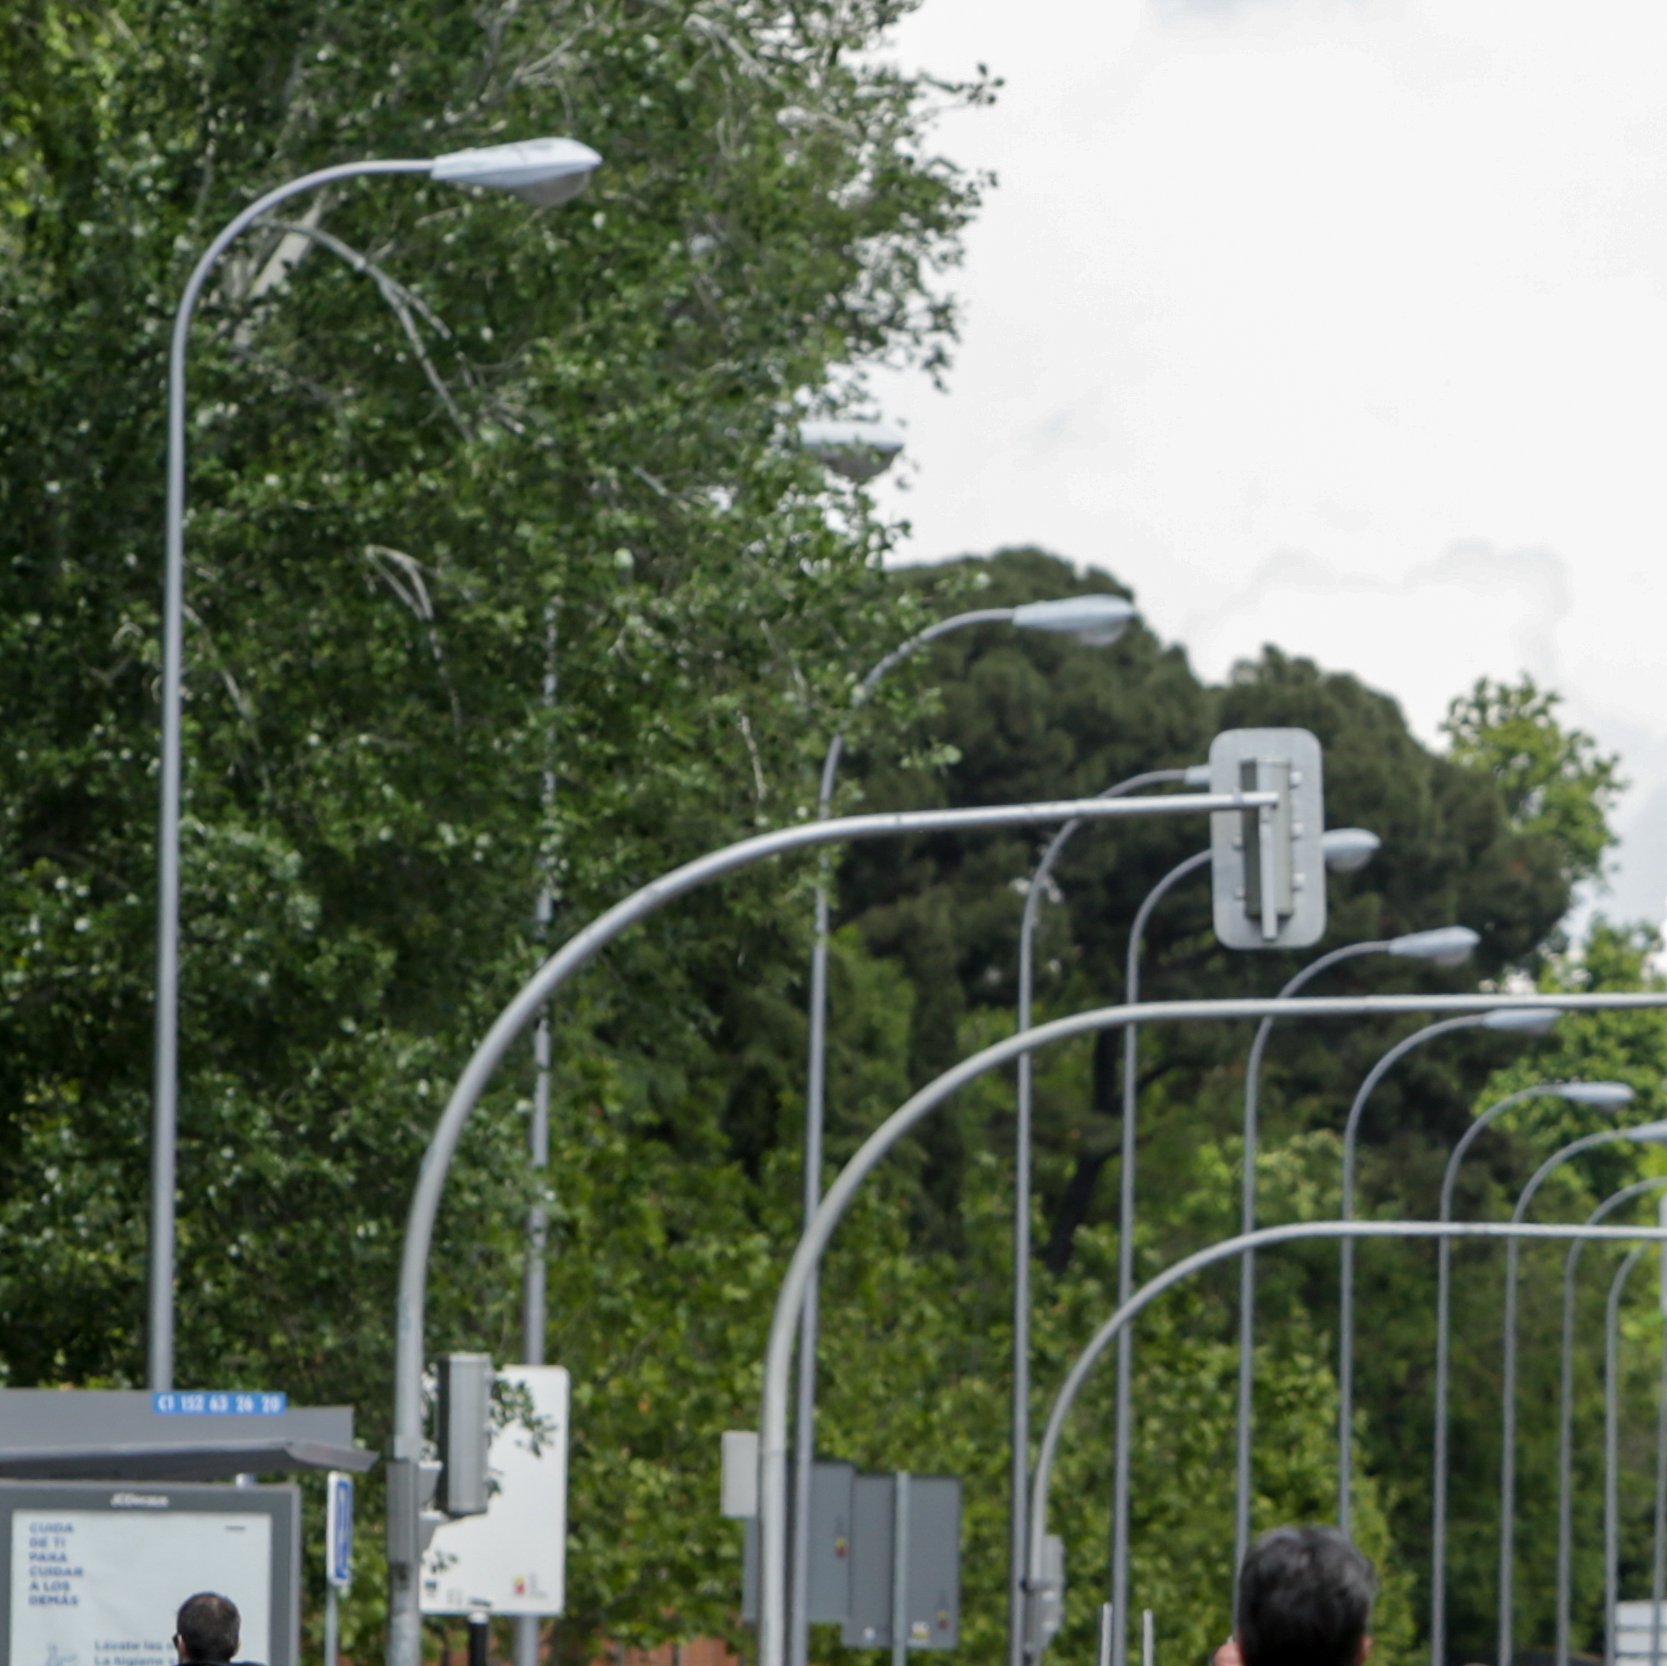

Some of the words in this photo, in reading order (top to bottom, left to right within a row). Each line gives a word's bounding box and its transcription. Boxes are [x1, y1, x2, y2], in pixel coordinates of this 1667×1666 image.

[181, 1395, 204, 1412] 152
[209, 1395, 228, 1412] 63
[235, 1395, 255, 1413] 26
[29, 1522, 75, 1534] CUIDA
[29, 1566, 84, 1577] CUIDAR
